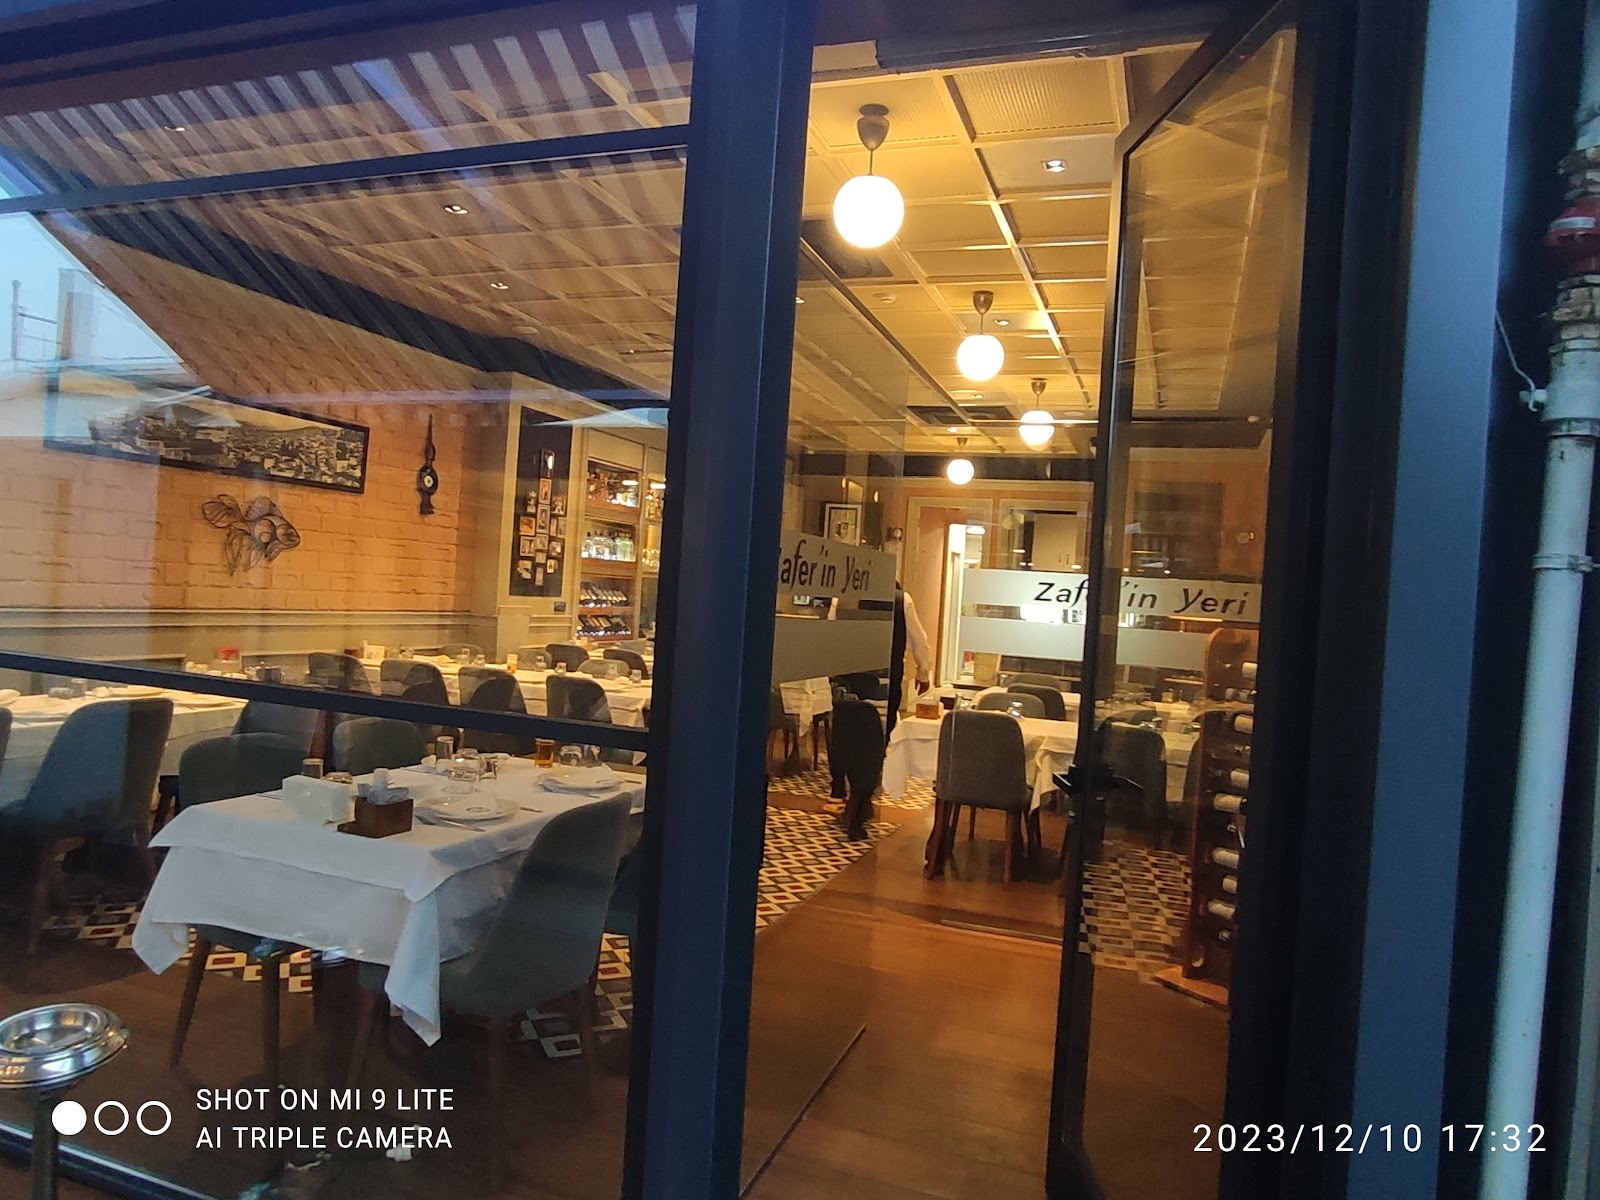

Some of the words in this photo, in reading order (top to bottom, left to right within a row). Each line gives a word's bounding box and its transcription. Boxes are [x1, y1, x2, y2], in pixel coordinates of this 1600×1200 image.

[778, 539, 836, 591] afer'in
[841, 555, 873, 594] Yeri
[1033, 578, 1158, 609] Zaf'in
[1173, 587, 1250, 615] Yeri
